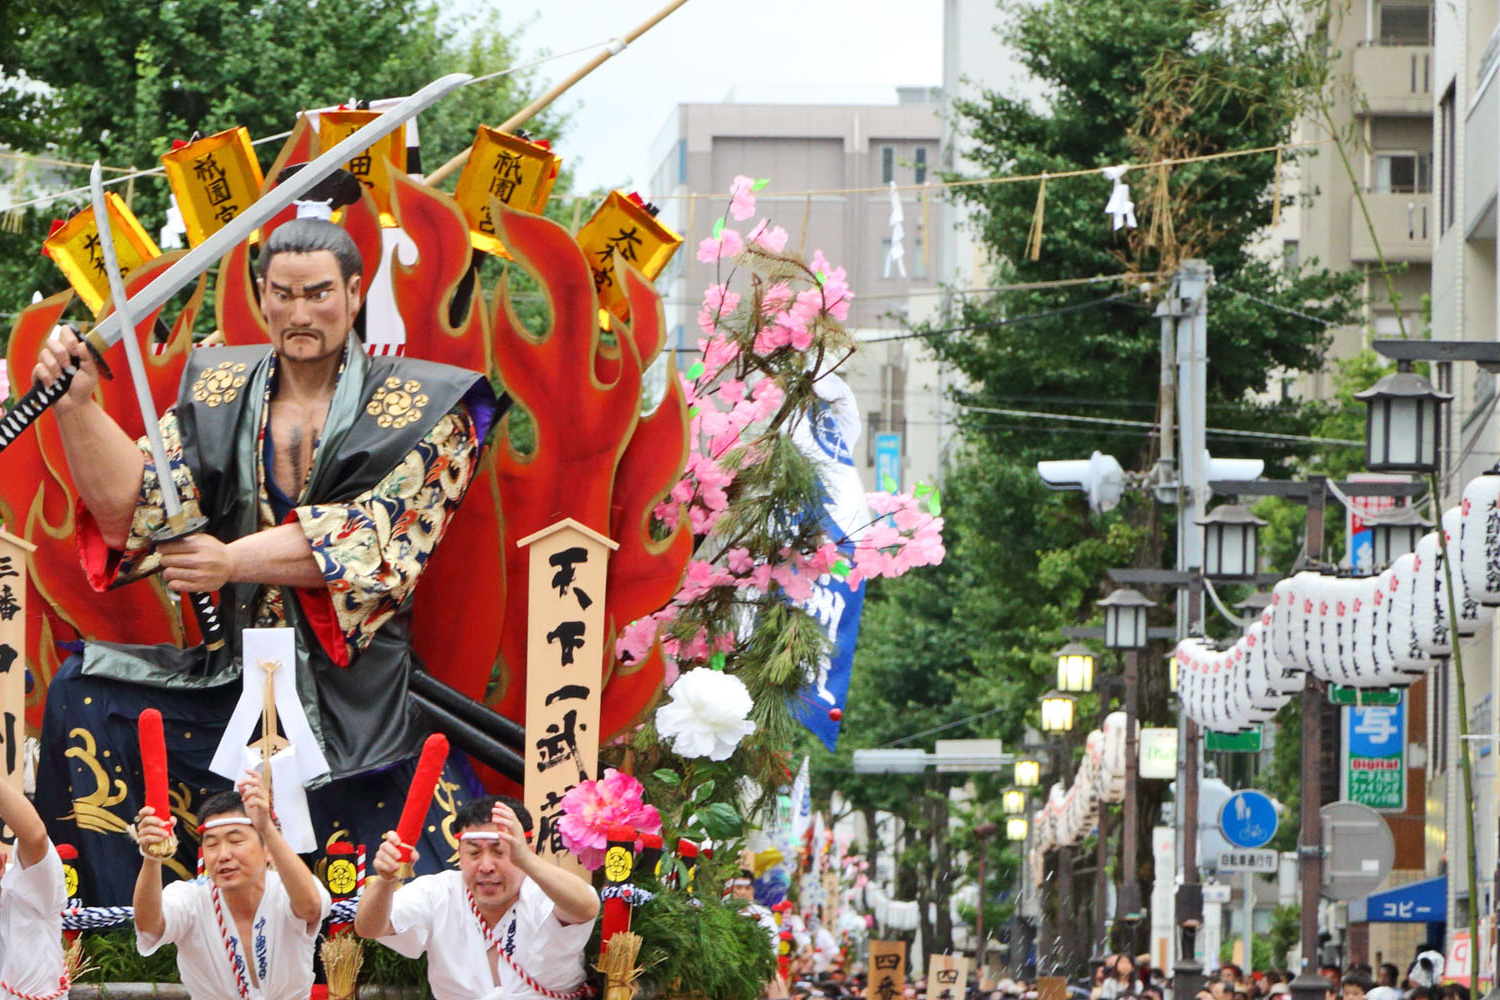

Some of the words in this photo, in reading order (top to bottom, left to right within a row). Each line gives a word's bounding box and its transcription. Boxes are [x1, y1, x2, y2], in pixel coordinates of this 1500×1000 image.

[1352, 759, 1399, 771] Digital
[1383, 901, 1432, 918] コピー
